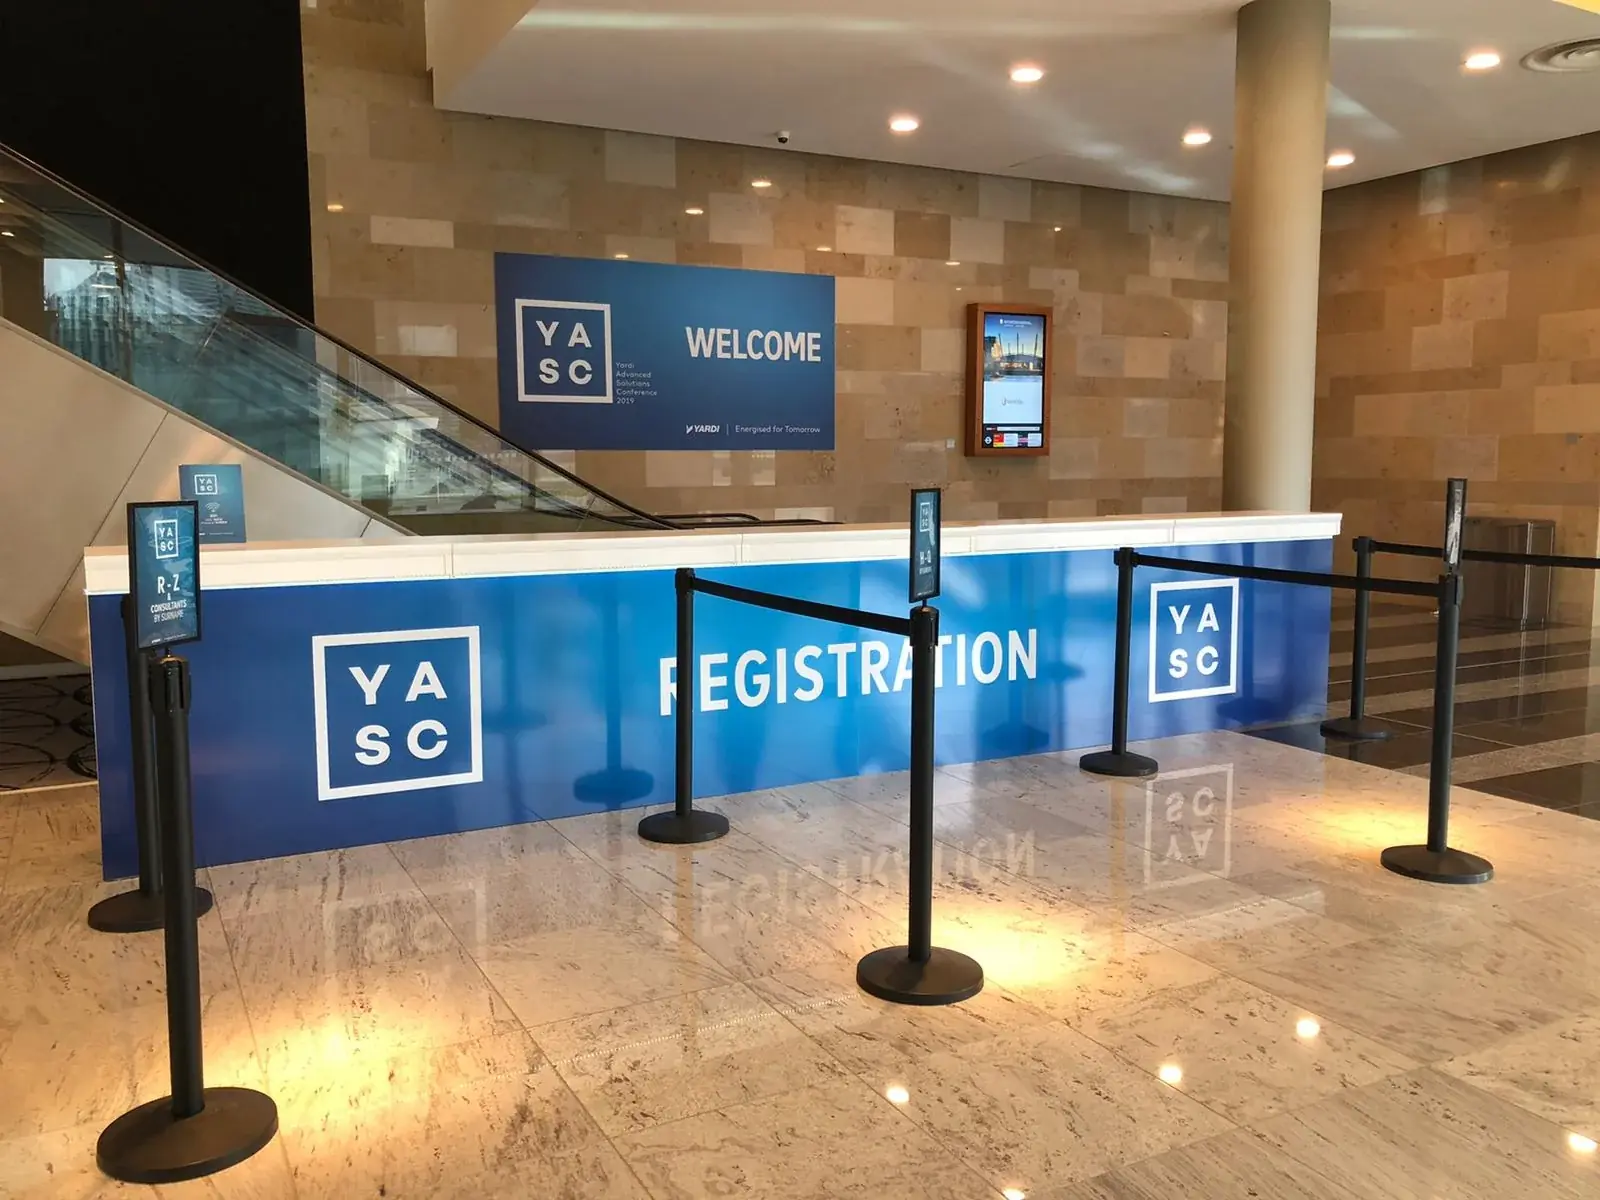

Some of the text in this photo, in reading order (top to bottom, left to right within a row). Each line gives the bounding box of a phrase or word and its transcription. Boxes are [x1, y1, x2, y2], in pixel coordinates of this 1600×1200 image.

[685, 326, 821, 362] WELCOME
[694, 425, 720, 433] YARDI
[735, 424, 821, 435] Energised for Tomorrow
[150, 599, 187, 614] CONSULTANTS
